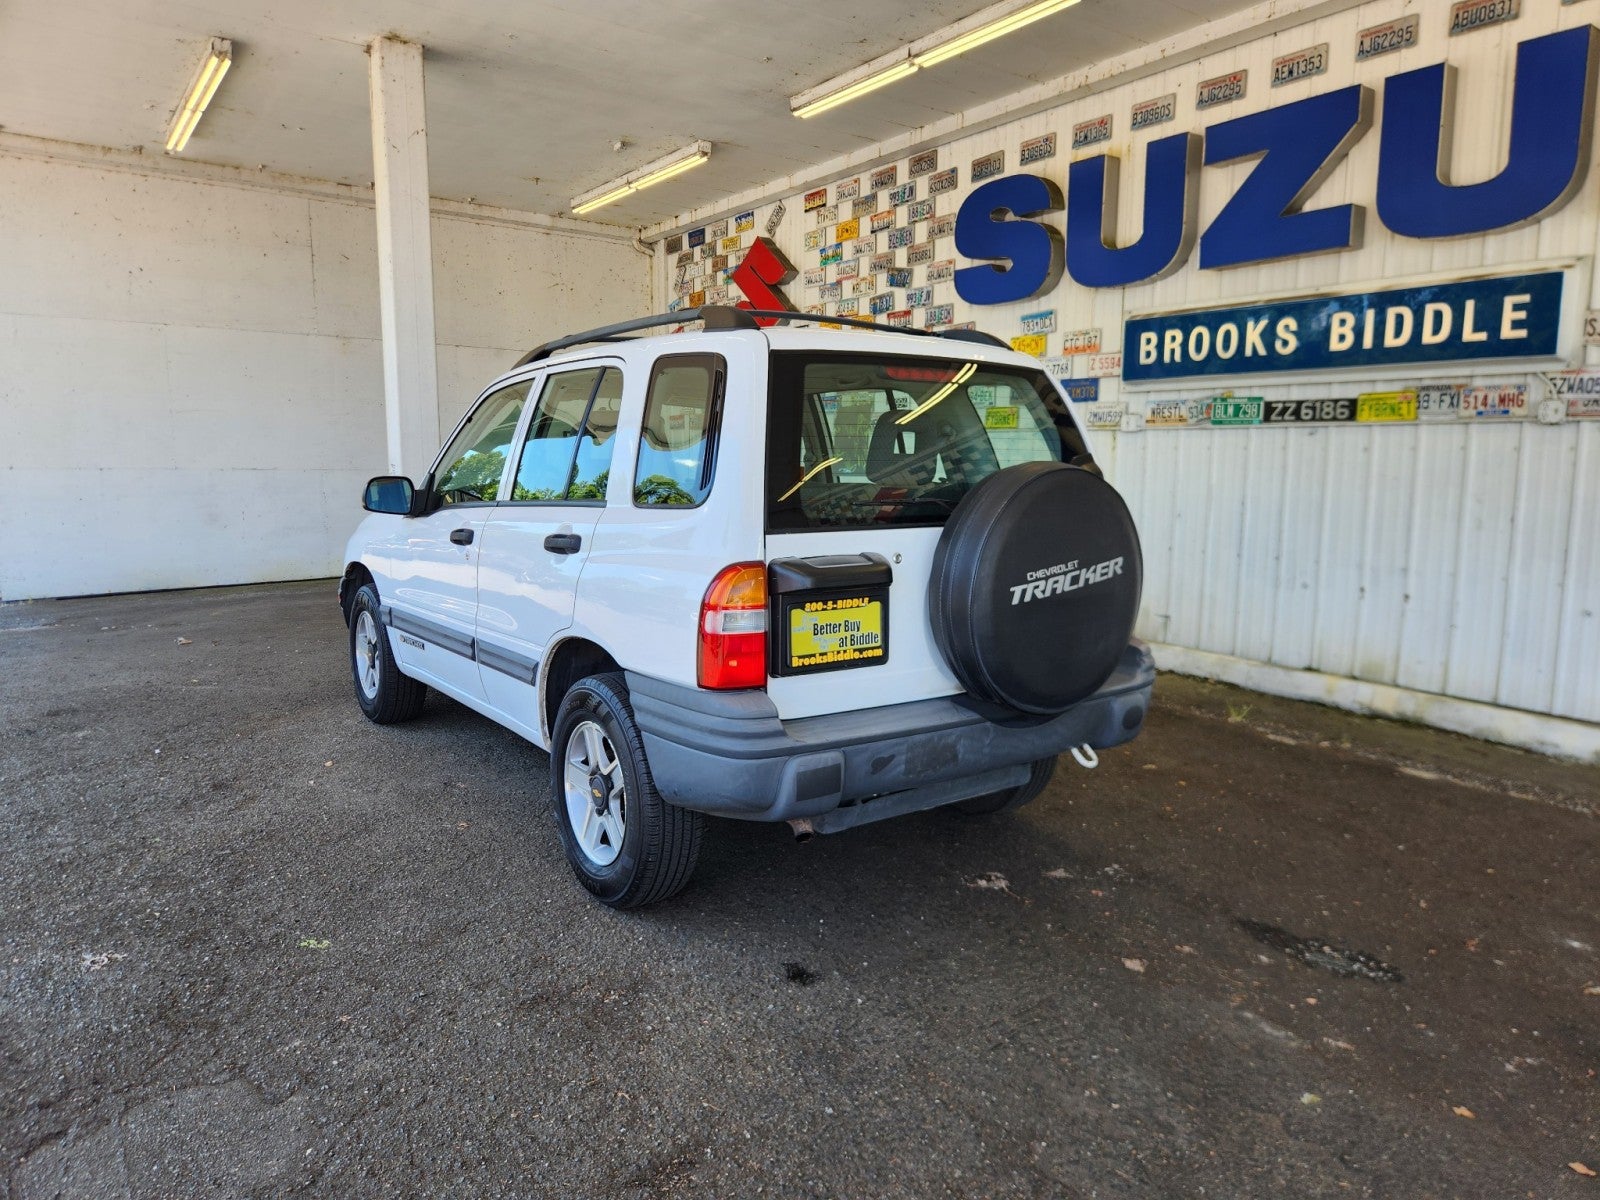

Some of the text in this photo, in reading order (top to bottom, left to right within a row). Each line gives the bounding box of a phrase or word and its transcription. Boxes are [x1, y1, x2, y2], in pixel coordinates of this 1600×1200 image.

[1357, 25, 1413, 56] AJG2295
[1274, 54, 1322, 82] AEW1353
[1198, 81, 1241, 104] AJG2295
[954, 24, 1599, 305] SUZU
[1138, 293, 1532, 366] BROOKS BIDDLE
[1009, 556, 1124, 605] TRACKER
[1027, 559, 1080, 581] CHEVROLET
[813, 620, 861, 636] Better Buy
[838, 632, 879, 648] at Biddle
[791, 648, 883, 668] BrooksBiddle.com
